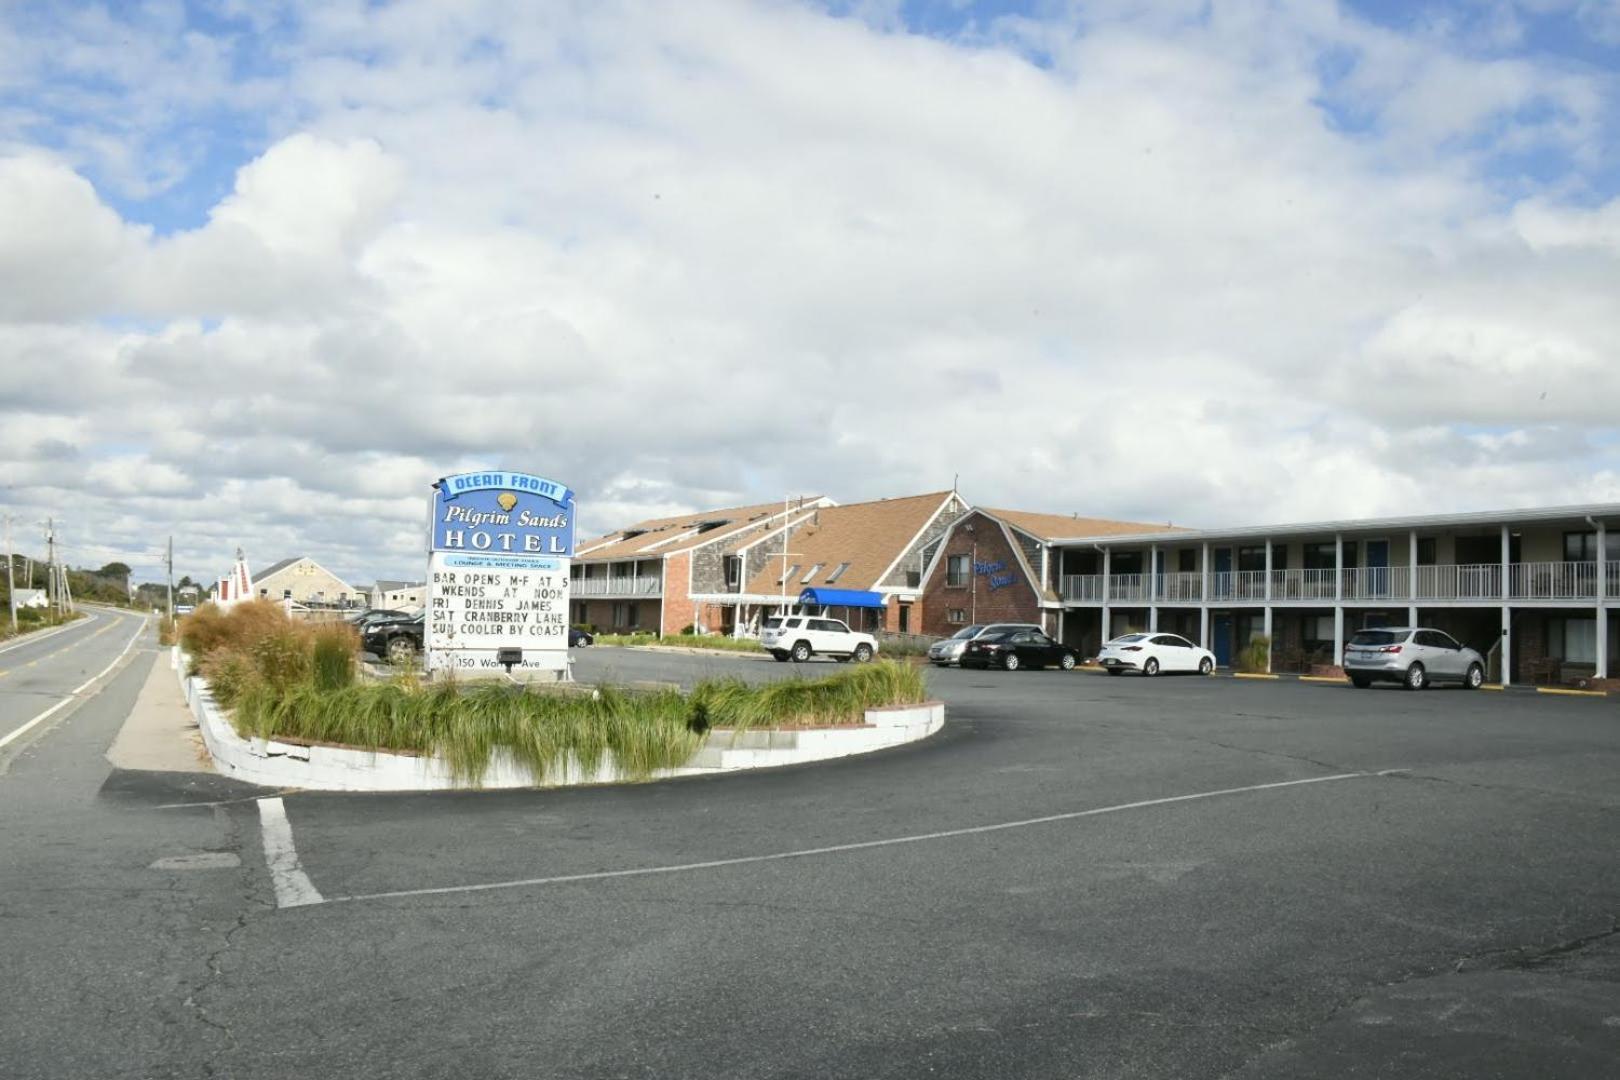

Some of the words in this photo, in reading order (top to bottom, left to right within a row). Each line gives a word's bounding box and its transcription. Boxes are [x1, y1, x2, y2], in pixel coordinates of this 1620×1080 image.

[455, 474, 503, 489] OCEAN
[511, 475, 557, 495] FRONT
[444, 506, 509, 528] Pilgrim
[517, 510, 568, 527] Sands
[444, 530, 567, 553] HOTEL
[434, 573, 456, 583] BAR
[464, 574, 501, 586] OPENS
[510, 576, 529, 586] M-F
[539, 577, 552, 587] AT
[562, 577, 568, 588] 5
[442, 586, 485, 597] WKENDS
[504, 588, 517, 598] AT
[534, 589, 563, 600] NOON
[433, 598, 449, 609] FRI
[465, 599, 504, 610] DENNIS
[515, 601, 552, 611] JAMES
[433, 610, 455, 621] SAT
[464, 611, 528, 623] CRANBERRY
[536, 613, 563, 624] LANE
[432, 623, 453, 634] SUN
[460, 624, 503, 635] COOLER
[509, 625, 524, 636] BY
[529, 626, 565, 637] COAST
[458, 658, 475, 668] 150
[521, 658, 540, 668] Ave
